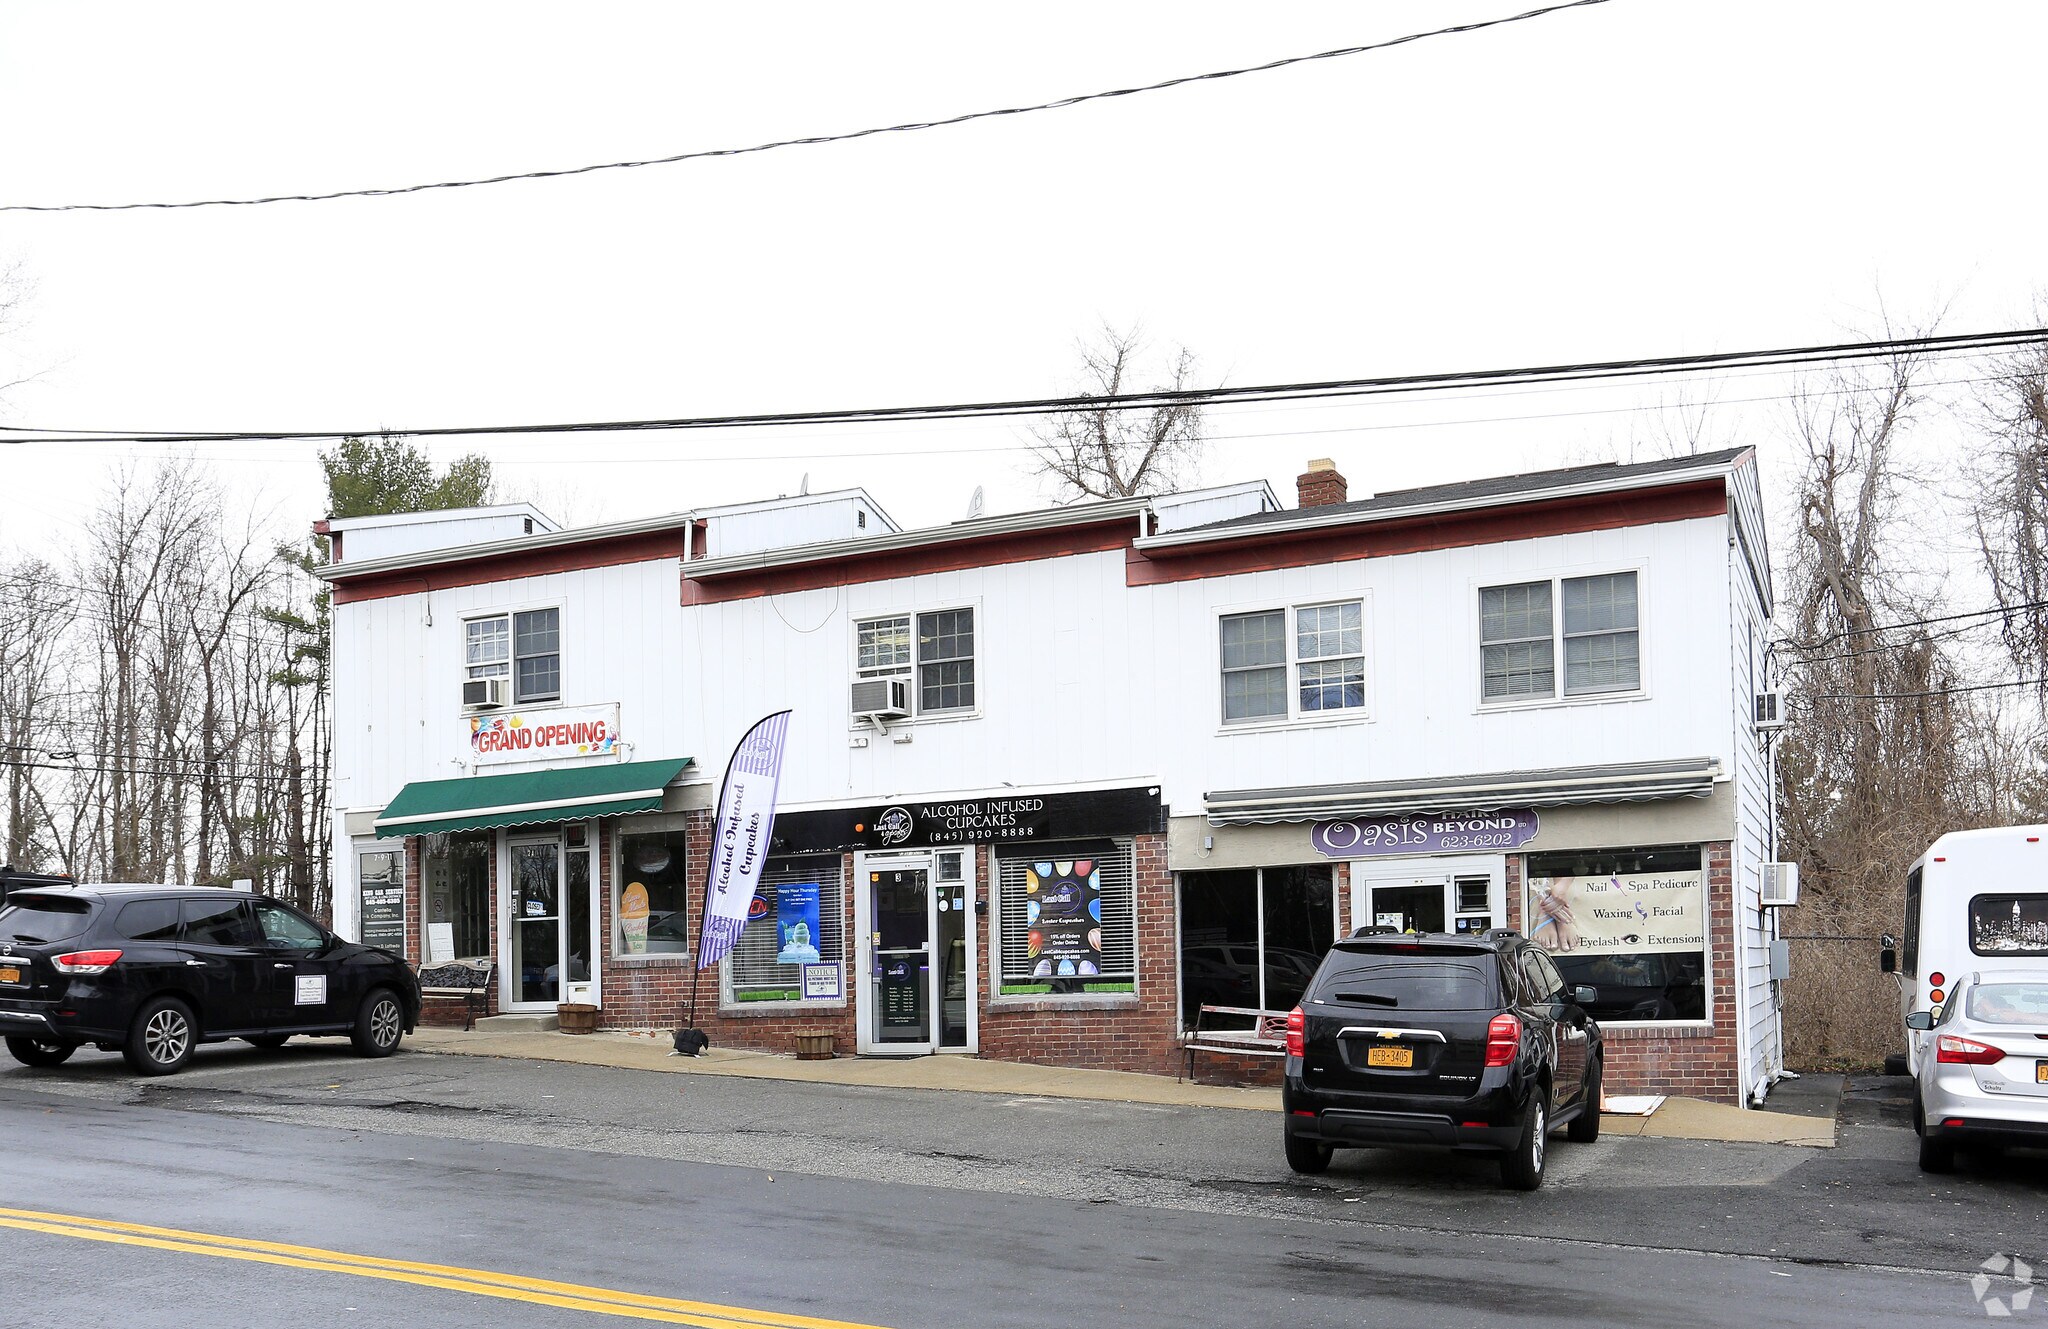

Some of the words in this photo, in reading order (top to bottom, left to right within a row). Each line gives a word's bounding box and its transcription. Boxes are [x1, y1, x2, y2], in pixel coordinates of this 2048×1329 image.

[478, 728, 532, 753] GRAND
[534, 720, 606, 748] OPENING
[725, 783, 745, 841] Infused
[921, 802, 983, 819] ALCOHOL
[986, 798, 1044, 815] INFUSED
[946, 814, 1017, 829] CUPCAKES
[1432, 818, 1517, 834] BEYOND
[929, 830, 964, 844] (845)
[968, 827, 1034, 840] 920-8888
[1440, 833, 1513, 849] 623-6202
[739, 812, 761, 876] Cupcakes
[718, 843, 735, 896] Alcohol
[1586, 882, 1608, 892] Nail
[1628, 880, 1649, 892] Spa
[1652, 879, 1698, 890] Pedicure
[1593, 908, 1633, 920] Waxing
[1653, 906, 1684, 917] Facial
[1580, 936, 1620, 948] Eyelash
[1648, 934, 1705, 945] Extensions
